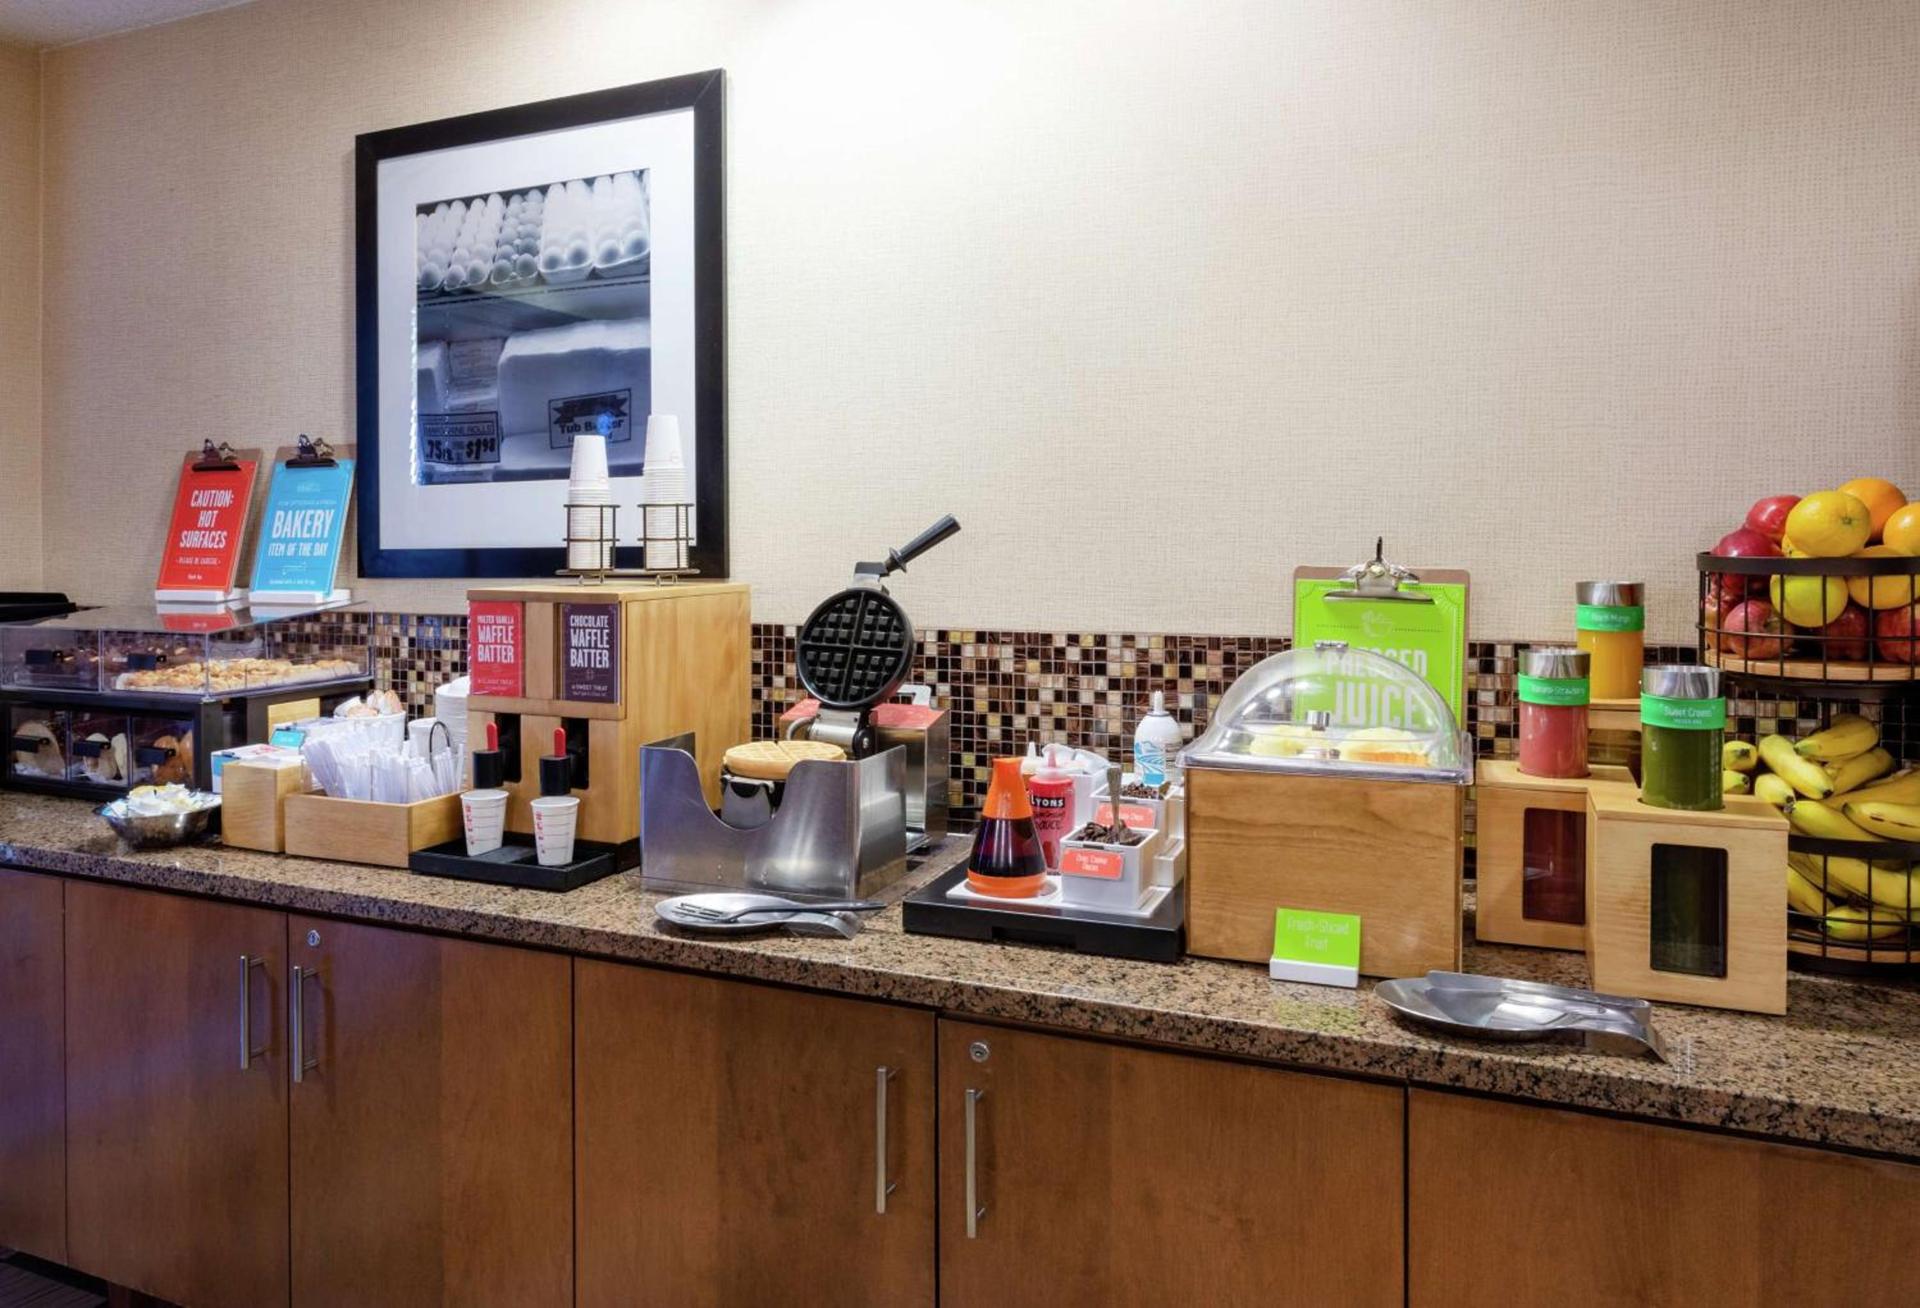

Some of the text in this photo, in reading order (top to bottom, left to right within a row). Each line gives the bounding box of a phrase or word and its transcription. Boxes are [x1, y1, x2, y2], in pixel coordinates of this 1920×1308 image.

[560, 419, 624, 434] Tub Ber
[190, 489, 235, 508] CAUTION:
[197, 510, 218, 528] HOT
[272, 508, 335, 539] BAKERY
[180, 530, 227, 549] SURFACES
[268, 543, 329, 557] ITEM OF THE DAY
[570, 615, 609, 628] CHOCOLATE
[478, 625, 514, 644] WAFFLE
[570, 628, 610, 648] WAFFLE
[478, 644, 514, 664] BATTER
[570, 648, 609, 668] BATTER
[1335, 681, 1418, 729] JUICE
